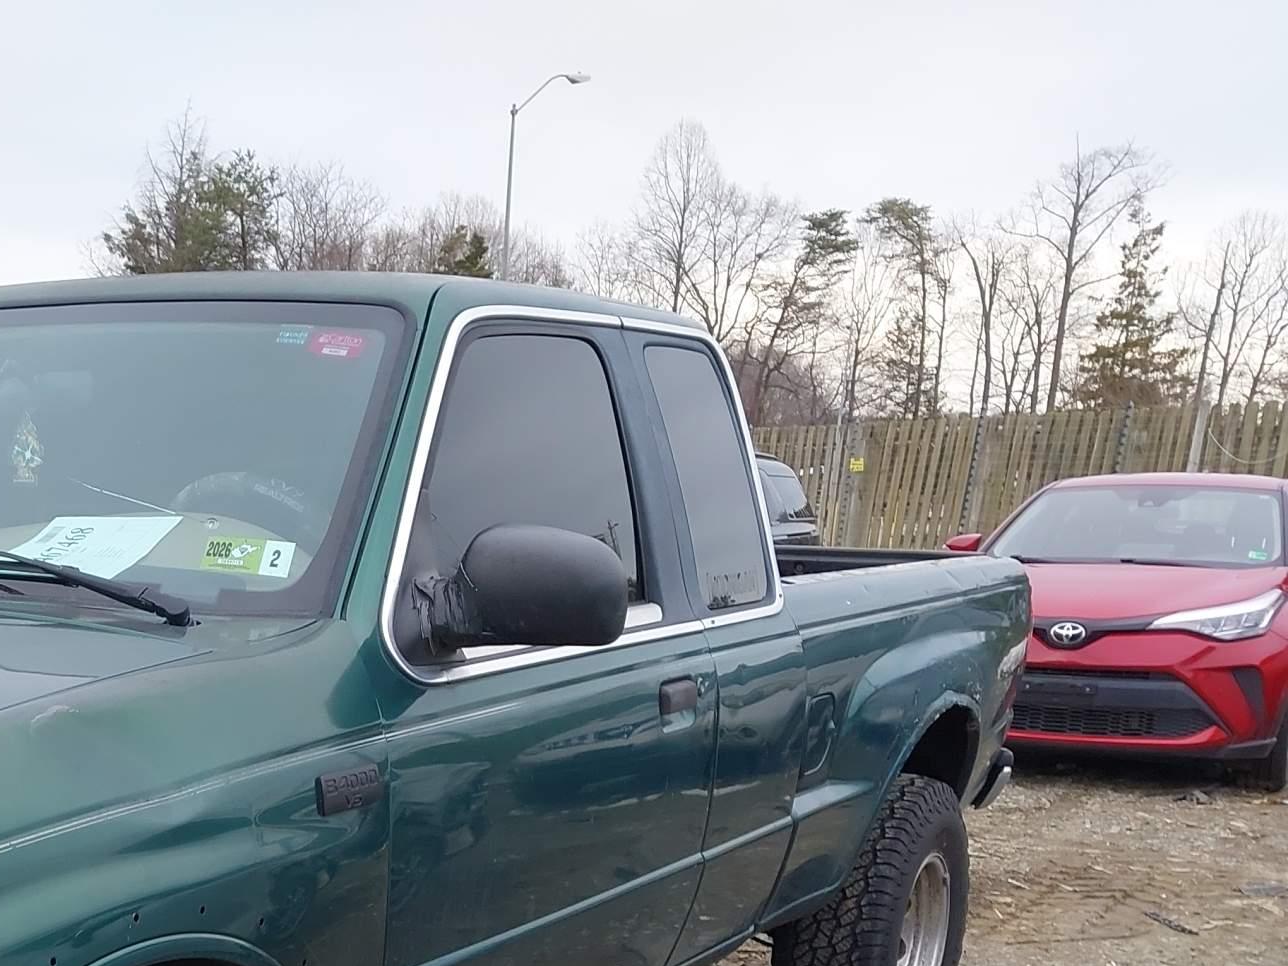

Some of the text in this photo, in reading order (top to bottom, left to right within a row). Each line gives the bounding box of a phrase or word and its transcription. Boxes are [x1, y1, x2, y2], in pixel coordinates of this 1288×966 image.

[205, 540, 282, 568] 2026 2
[324, 768, 379, 796] B4000
